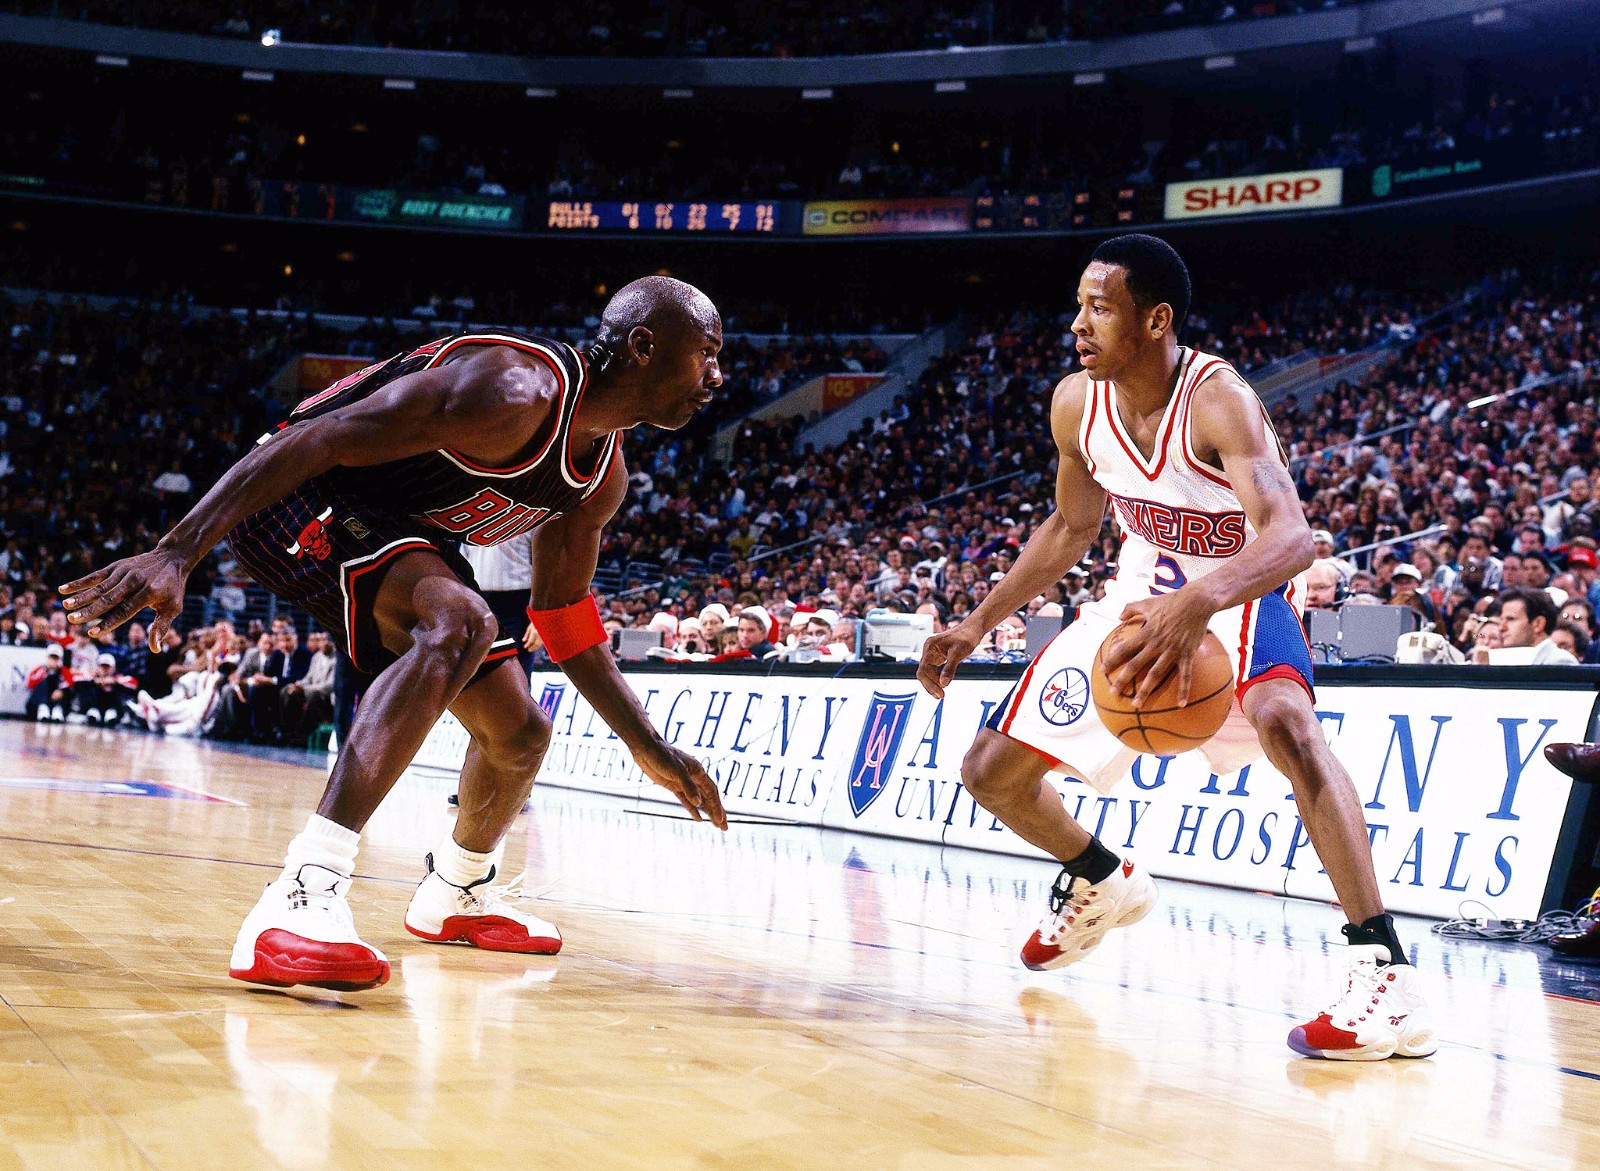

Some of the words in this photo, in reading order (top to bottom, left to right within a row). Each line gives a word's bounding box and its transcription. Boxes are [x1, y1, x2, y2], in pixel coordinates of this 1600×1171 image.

[1184, 178, 1322, 212] SHARP
[831, 206, 964, 226] COMCAST
[1043, 683, 1079, 717] 76ers
[1168, 804, 1519, 898] HOSPTALS
